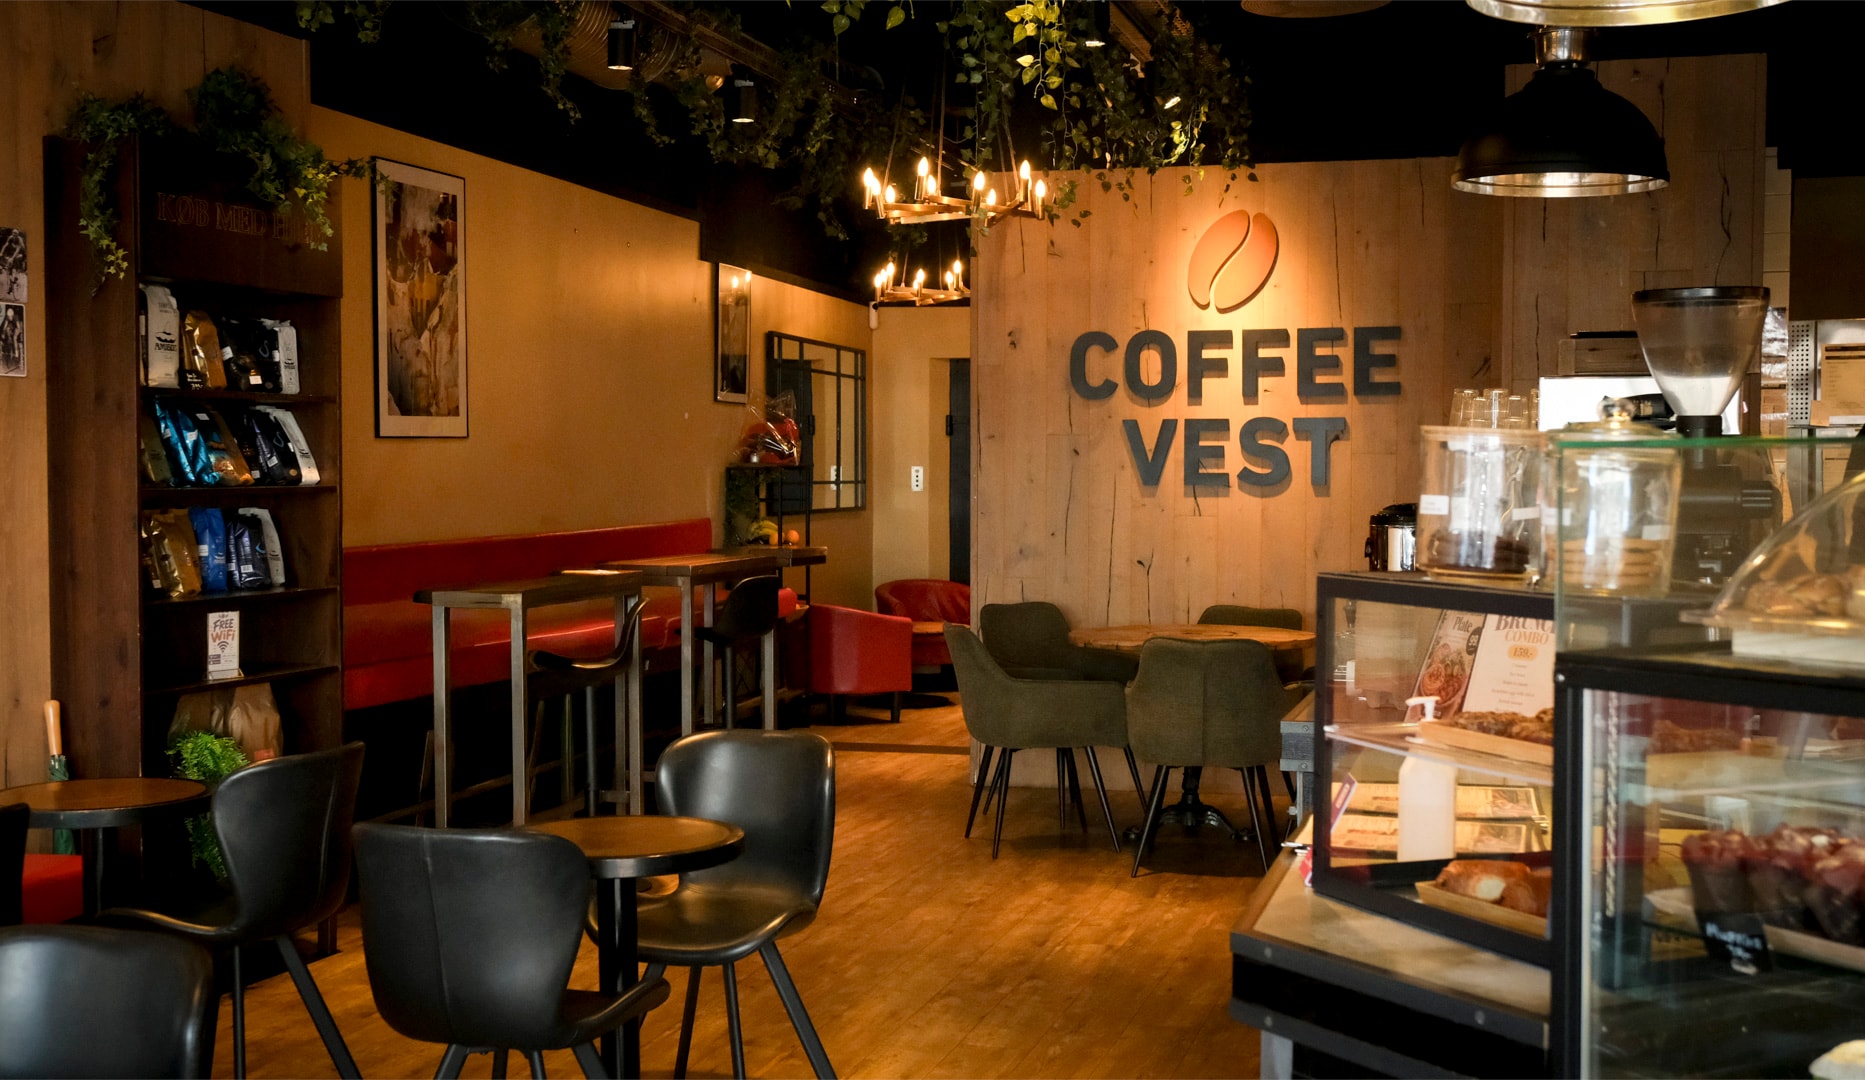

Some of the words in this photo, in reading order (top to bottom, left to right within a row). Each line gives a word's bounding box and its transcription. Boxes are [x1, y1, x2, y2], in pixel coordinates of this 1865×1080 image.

[216, 202, 267, 236] MED
[1069, 326, 1401, 404] COFFEE
[1122, 416, 1348, 491] VEST
[213, 618, 235, 632] FREE
[1452, 616, 1473, 633] Plate
[1504, 630, 1550, 645] COMBO
